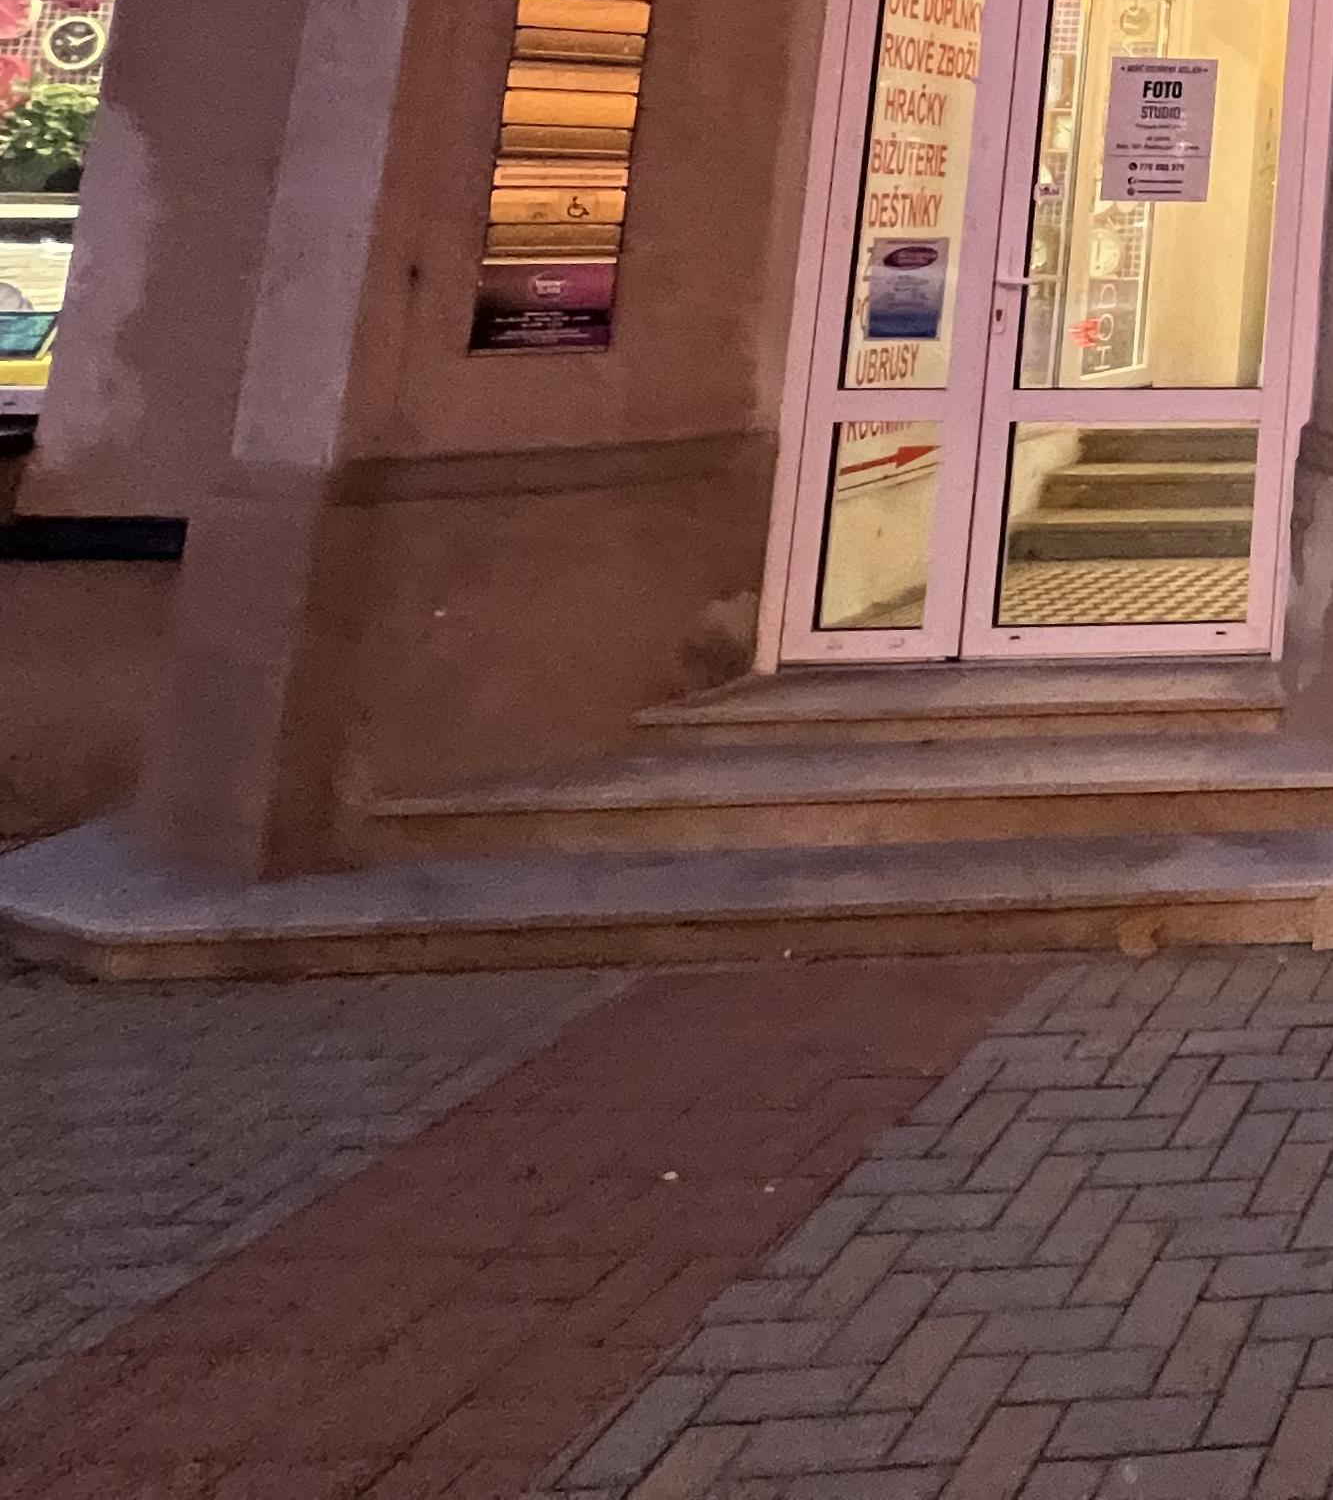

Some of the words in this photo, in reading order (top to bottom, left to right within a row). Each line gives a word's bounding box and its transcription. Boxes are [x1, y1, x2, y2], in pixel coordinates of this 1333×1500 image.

[884, 83, 948, 127] HRAČKY
[1142, 80, 1183, 99] FOTO
[1140, 105, 1182, 120] STUDIO
[870, 131, 948, 178] BIŽUTERIE
[868, 184, 943, 228] DEŠTNÍKY
[855, 342, 919, 386] UBRUSY
